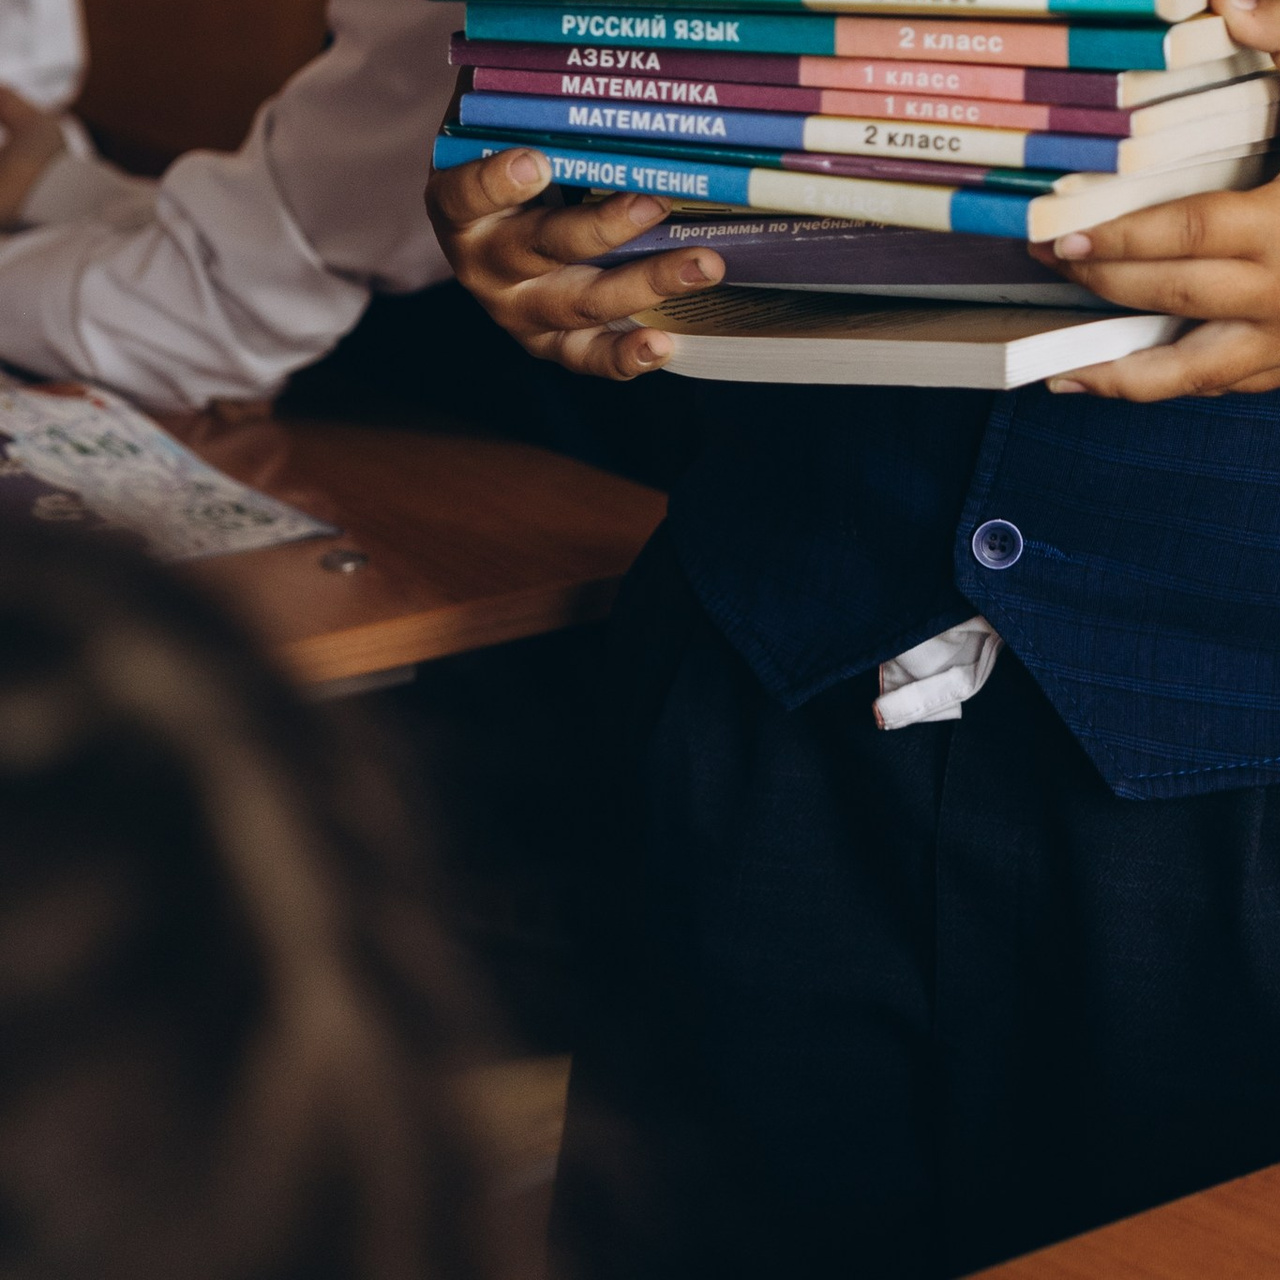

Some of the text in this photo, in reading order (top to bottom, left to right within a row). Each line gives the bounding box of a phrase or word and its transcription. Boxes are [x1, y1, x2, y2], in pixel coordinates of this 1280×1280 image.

[561, 13, 741, 43] РУССКИЙ ЯЗЫК
[898, 26, 1004, 53] 2 класс
[566, 47, 661, 71] АЗБУКА
[561, 75, 719, 105] МАТЕМАТИКА
[863, 64, 961, 91] 1 класс
[568, 106, 727, 137] МАТЕМАТИКА
[884, 95, 981, 122] 1 класс
[863, 124, 962, 152] 2 класс
[631, 166, 710, 197] ЧТЕНИЕ
[669, 223, 764, 241] Программы
[768, 221, 788, 233] по
